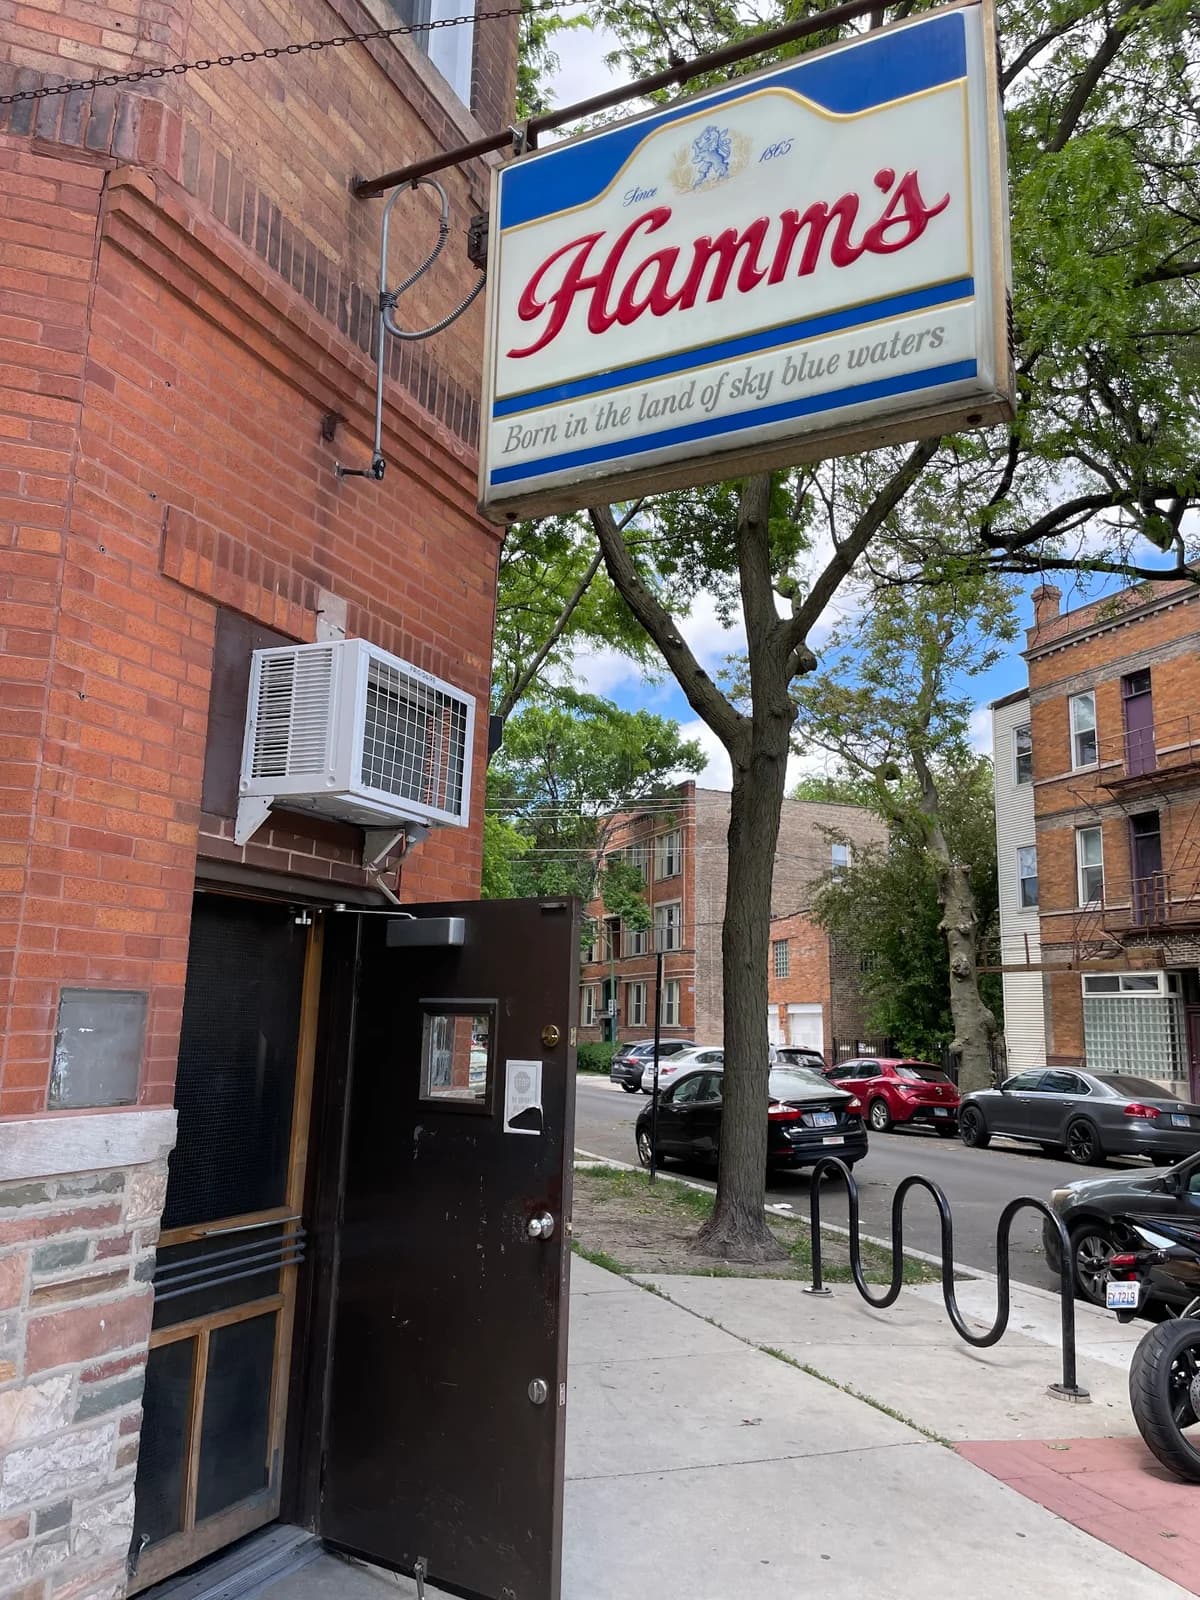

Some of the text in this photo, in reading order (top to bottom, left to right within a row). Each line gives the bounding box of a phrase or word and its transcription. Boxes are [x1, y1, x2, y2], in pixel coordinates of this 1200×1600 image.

[623, 138, 795, 208] Since 1865
[506, 167, 951, 358] Hamm's
[501, 325, 946, 454] Born in the land of sky blue waters
